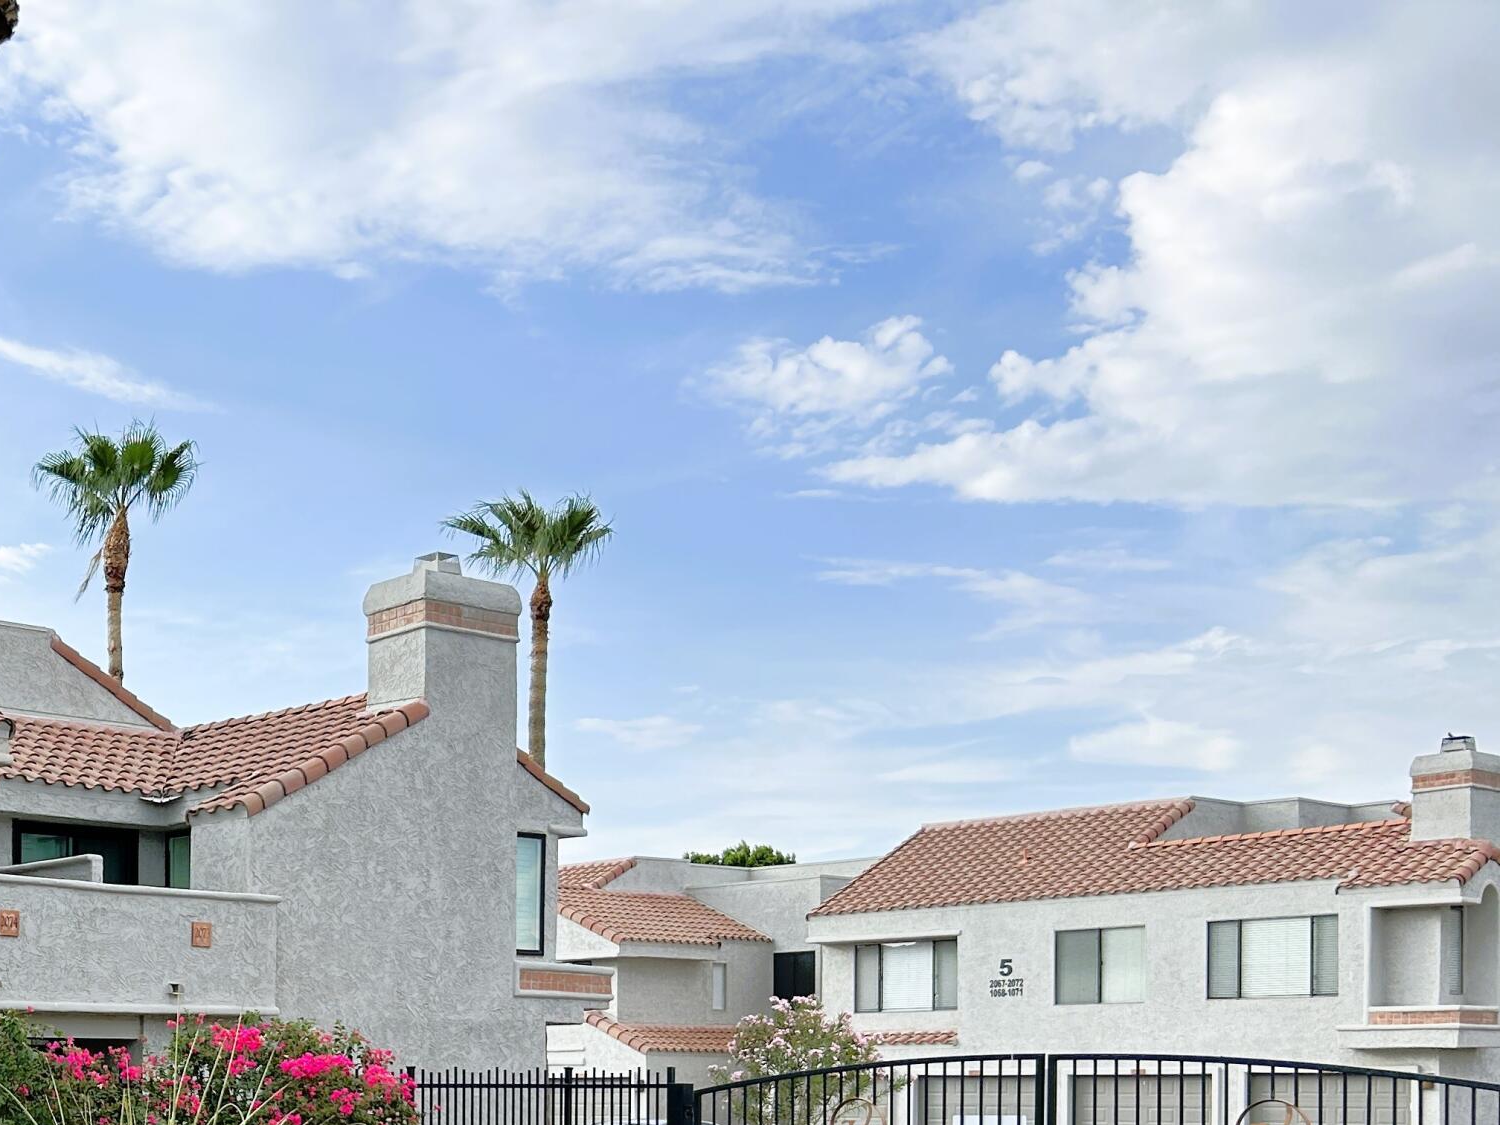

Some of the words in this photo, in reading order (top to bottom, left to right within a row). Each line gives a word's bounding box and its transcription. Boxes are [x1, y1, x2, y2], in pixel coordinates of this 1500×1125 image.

[999, 958, 1013, 977] 5
[989, 978, 1024, 988] 2067-2072
[989, 988, 1024, 997] 1068-1071
